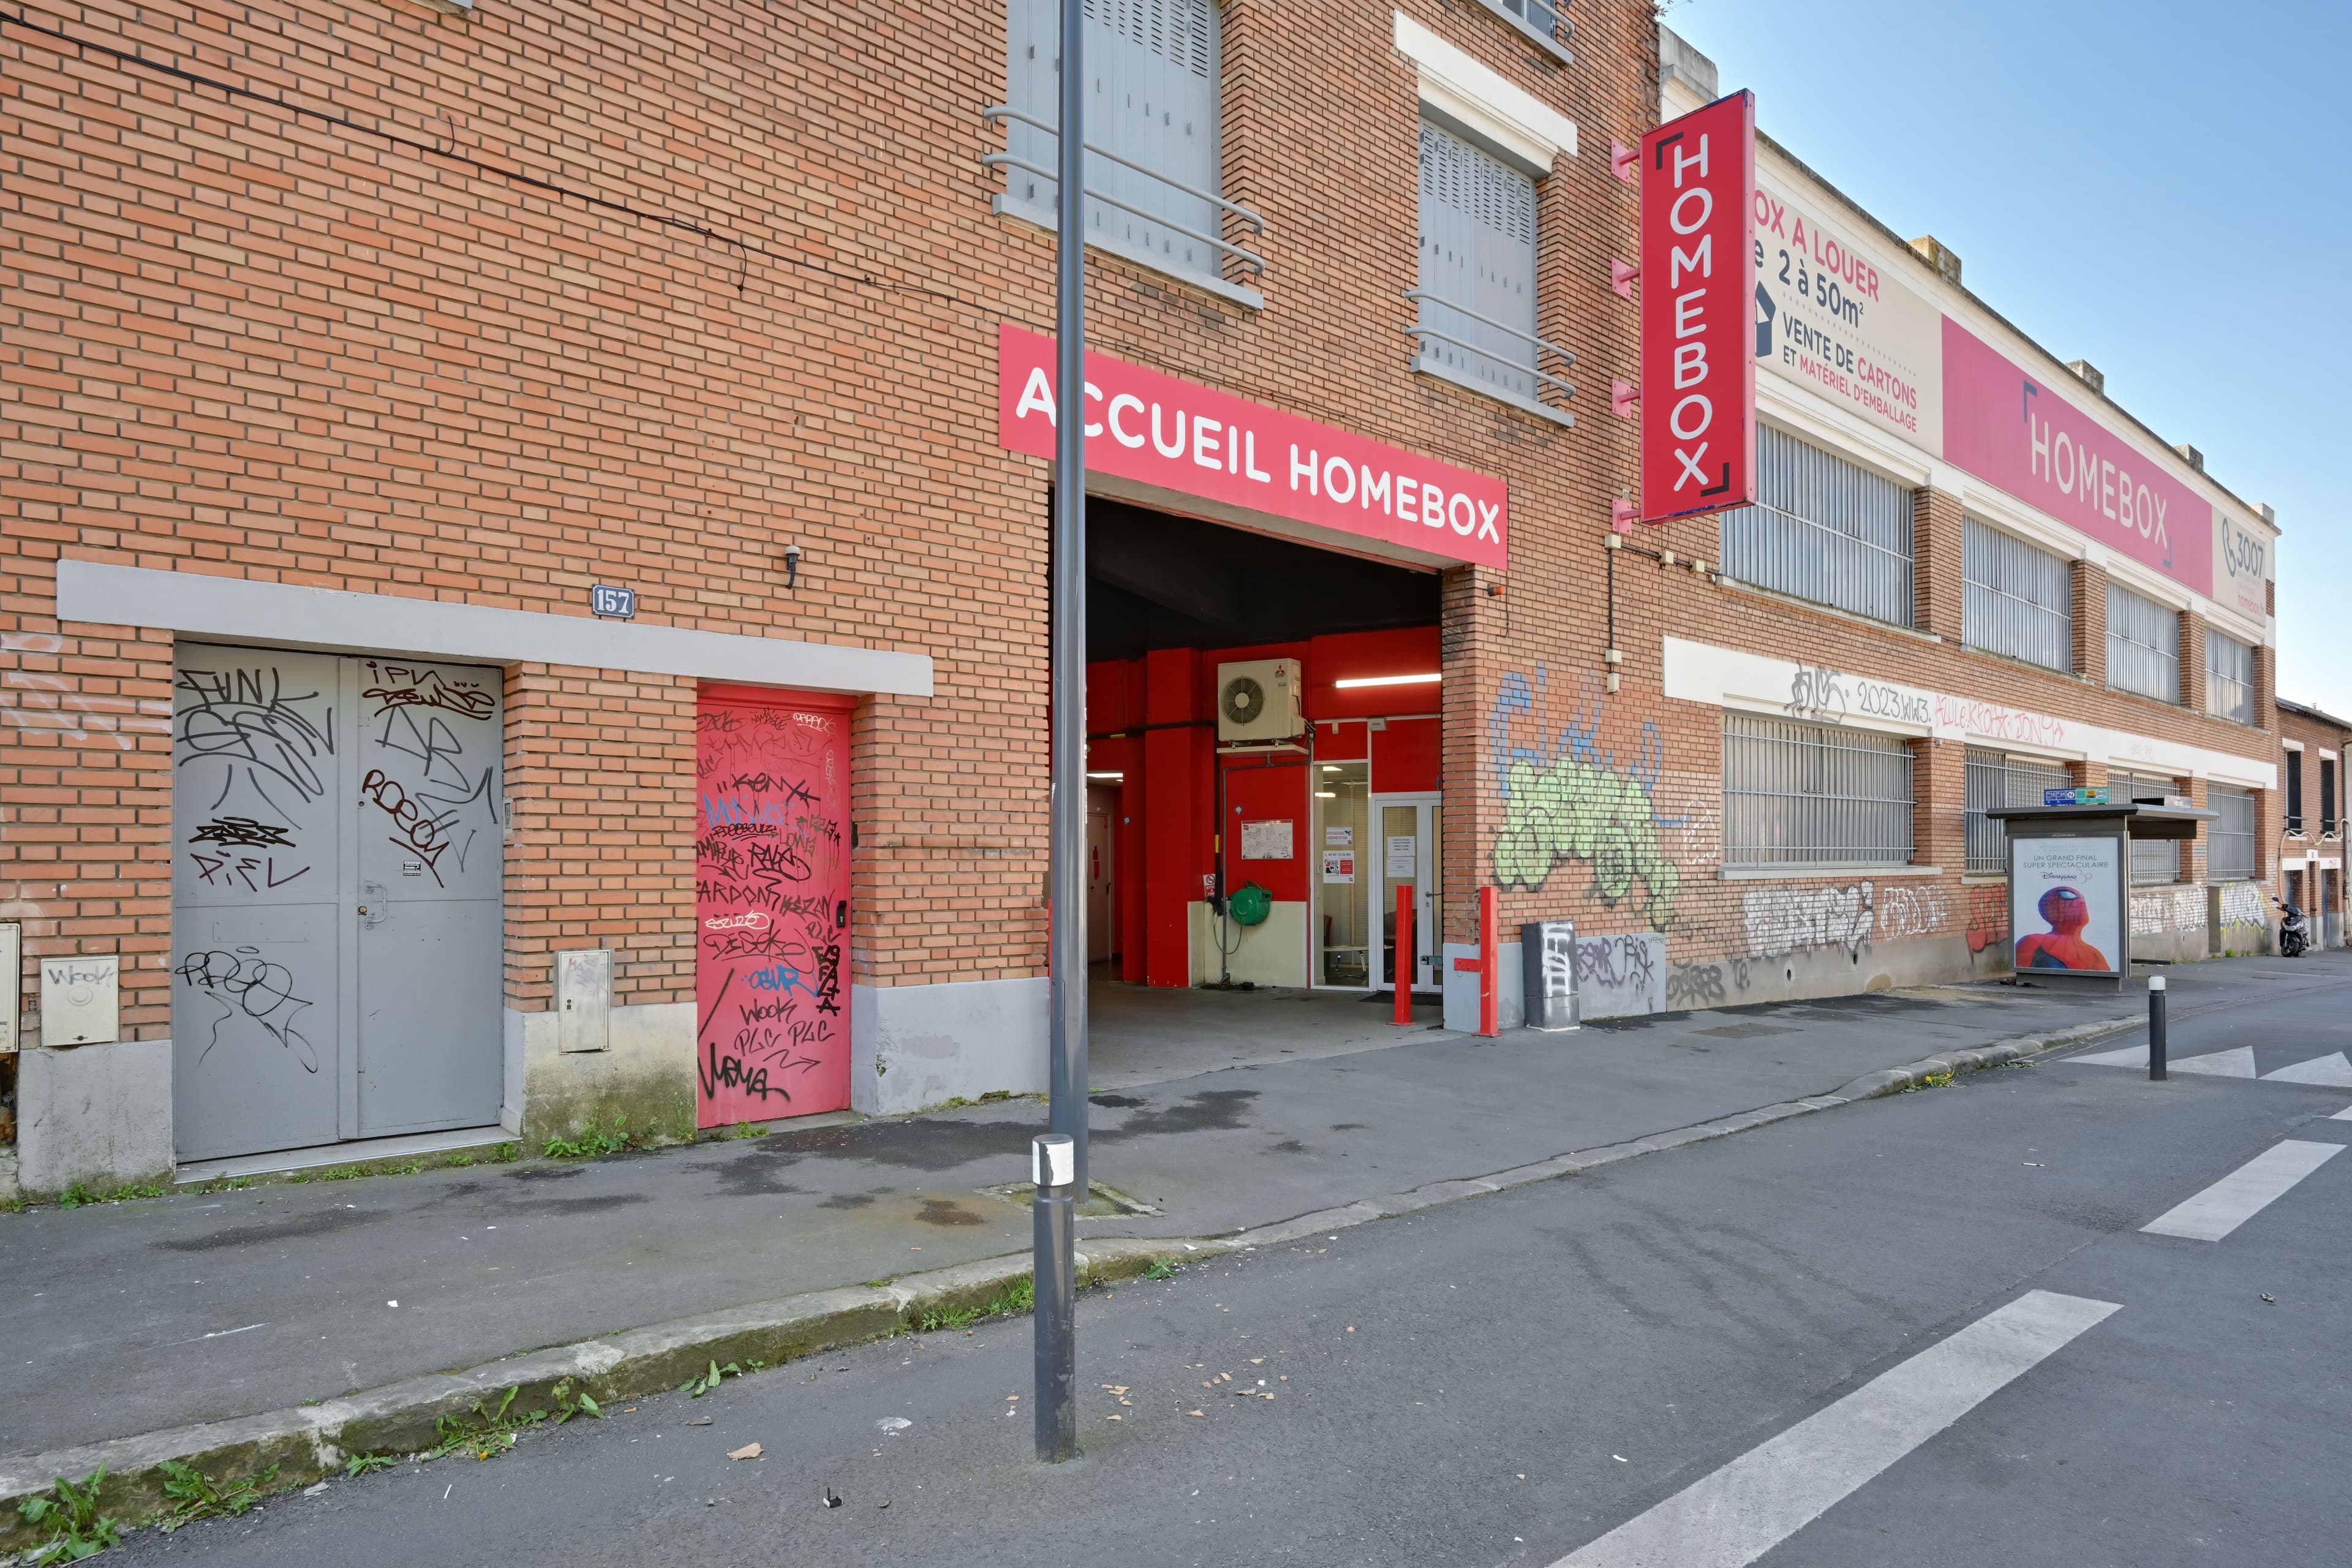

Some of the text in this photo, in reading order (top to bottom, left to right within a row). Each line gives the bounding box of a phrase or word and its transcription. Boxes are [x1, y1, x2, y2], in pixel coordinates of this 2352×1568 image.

[1779, 249, 1790, 285] 2
[1798, 258, 1809, 297] à
[1792, 217, 1807, 254] A
[1814, 230, 1879, 302] LOUER
[1670, 134, 1713, 491] HOMEBOX
[1783, 311, 1917, 410] VENTE DE CARTONS
[1783, 345, 1917, 433] ET MATÉRIEL D'EMBALLAGE
[1291, 443, 1500, 545] HOMEBOX
[2031, 412, 2168, 549] HOMEBOX
[2237, 531, 2263, 579] 3007
[597, 589, 629, 614] 157
[2237, 590, 2264, 616] homebox.fr
